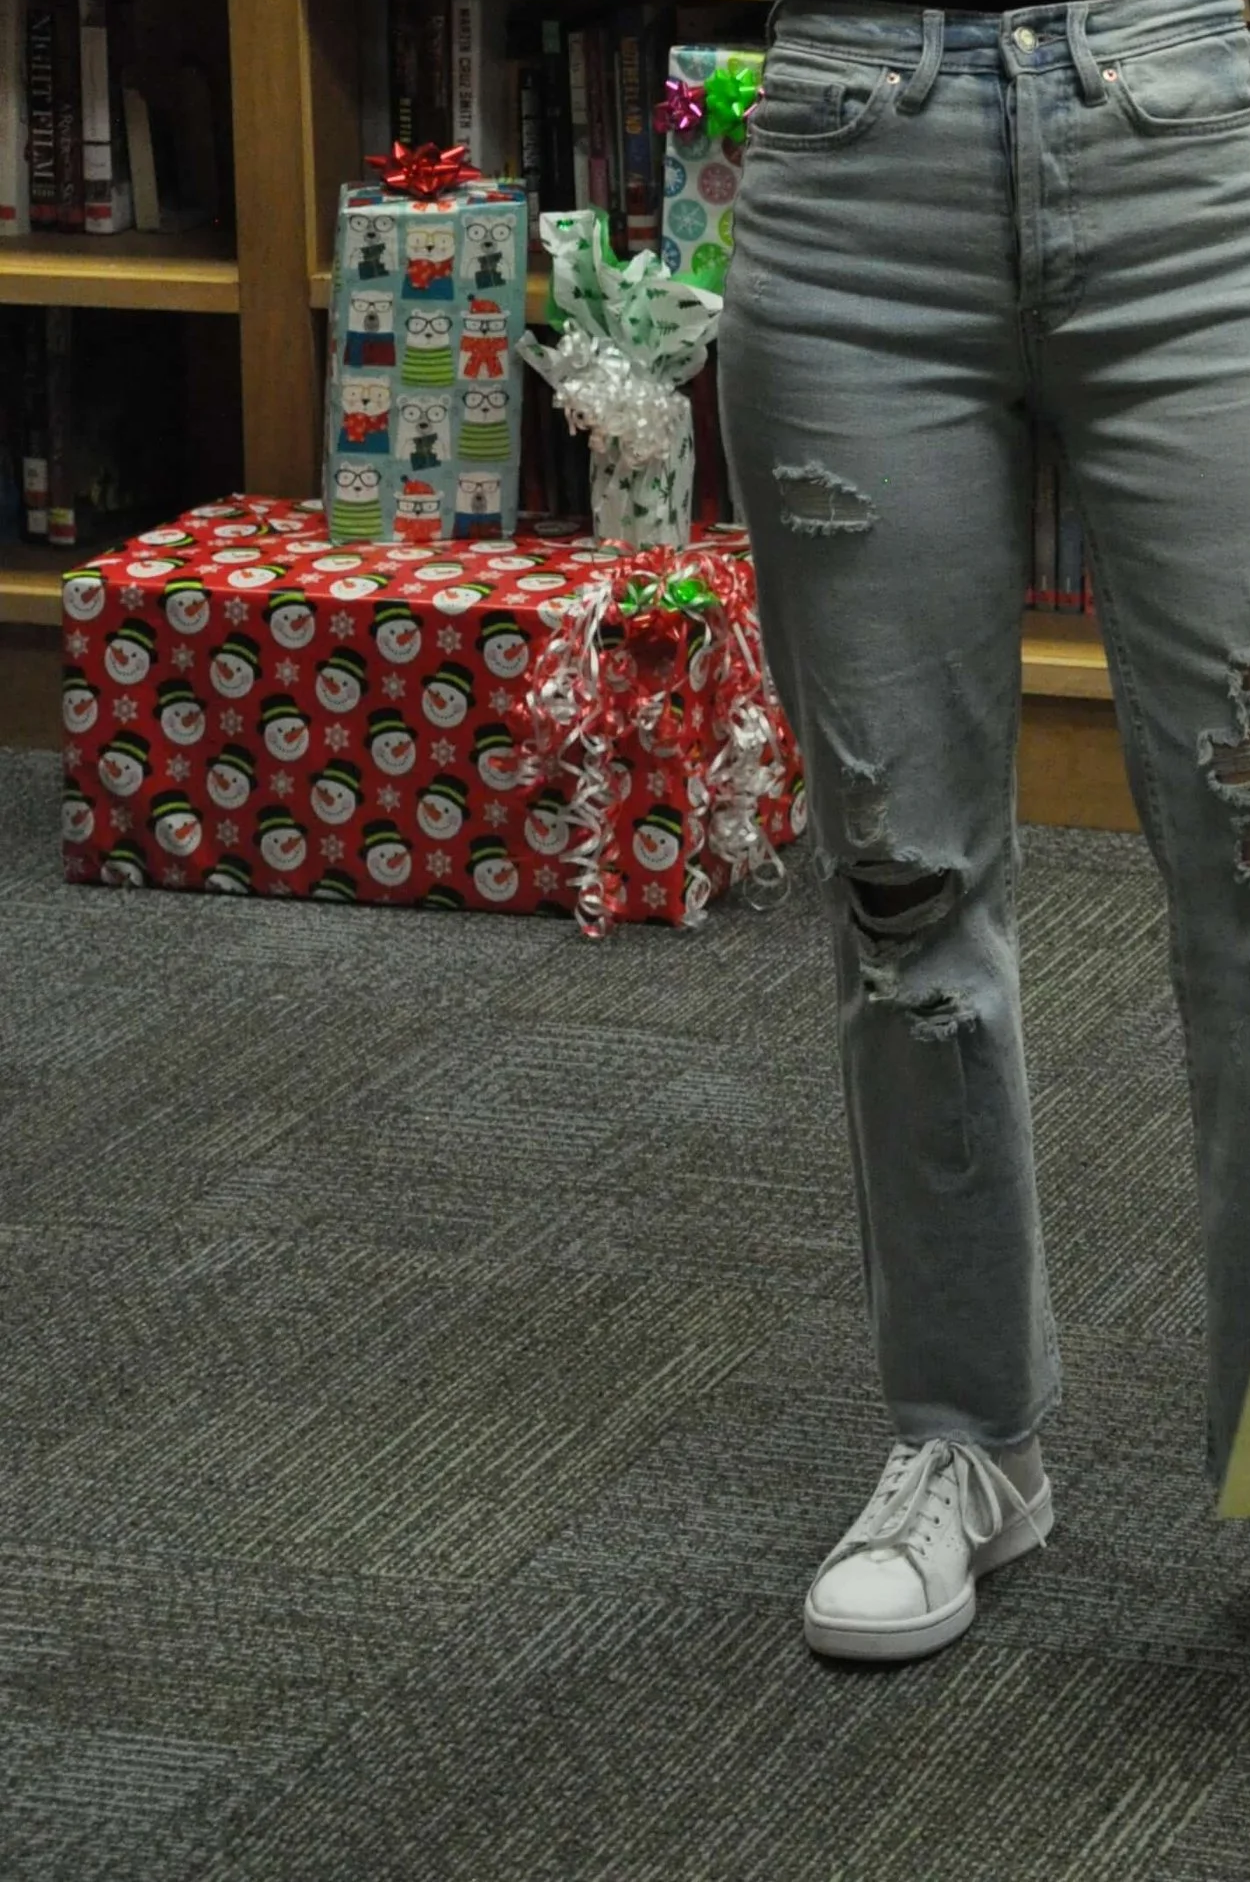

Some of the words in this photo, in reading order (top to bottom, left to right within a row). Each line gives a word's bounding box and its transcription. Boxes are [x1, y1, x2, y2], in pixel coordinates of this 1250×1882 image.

[458, 8, 472, 53] MARTIN
[31, 13, 53, 103] NIGHT
[458, 57, 472, 89] CRUZ
[458, 91, 472, 129] SMITH
[32, 110, 55, 179] FILM
